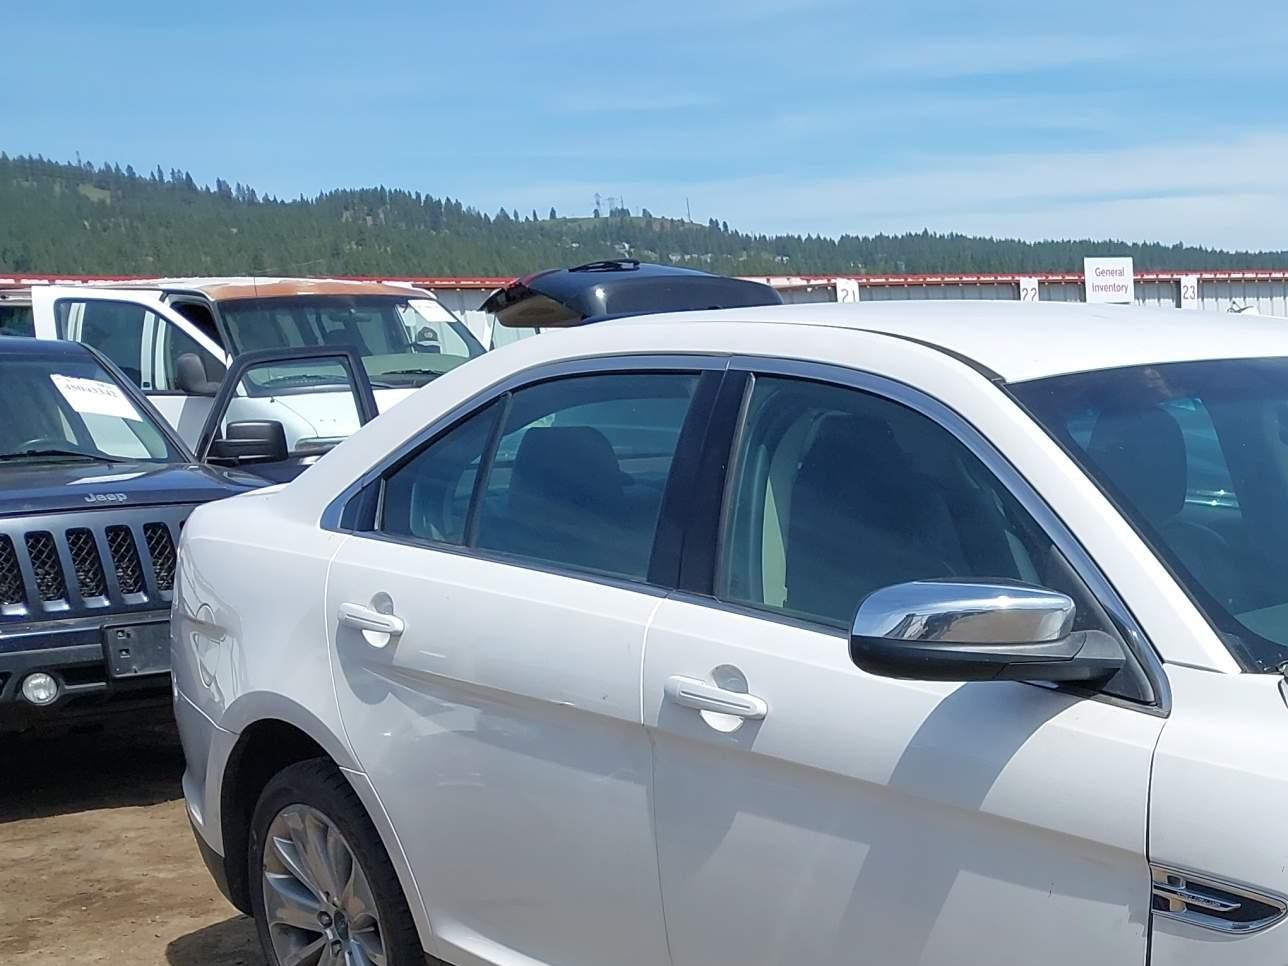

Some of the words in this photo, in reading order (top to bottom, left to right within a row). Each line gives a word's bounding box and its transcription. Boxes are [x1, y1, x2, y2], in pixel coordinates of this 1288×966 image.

[1094, 267, 1125, 277] General
[1021, 287, 1038, 301] 22
[1091, 282, 1129, 294] Inventory
[1183, 285, 1196, 300] 23
[841, 288, 856, 303] 21
[84, 493, 128, 502] Jeep
